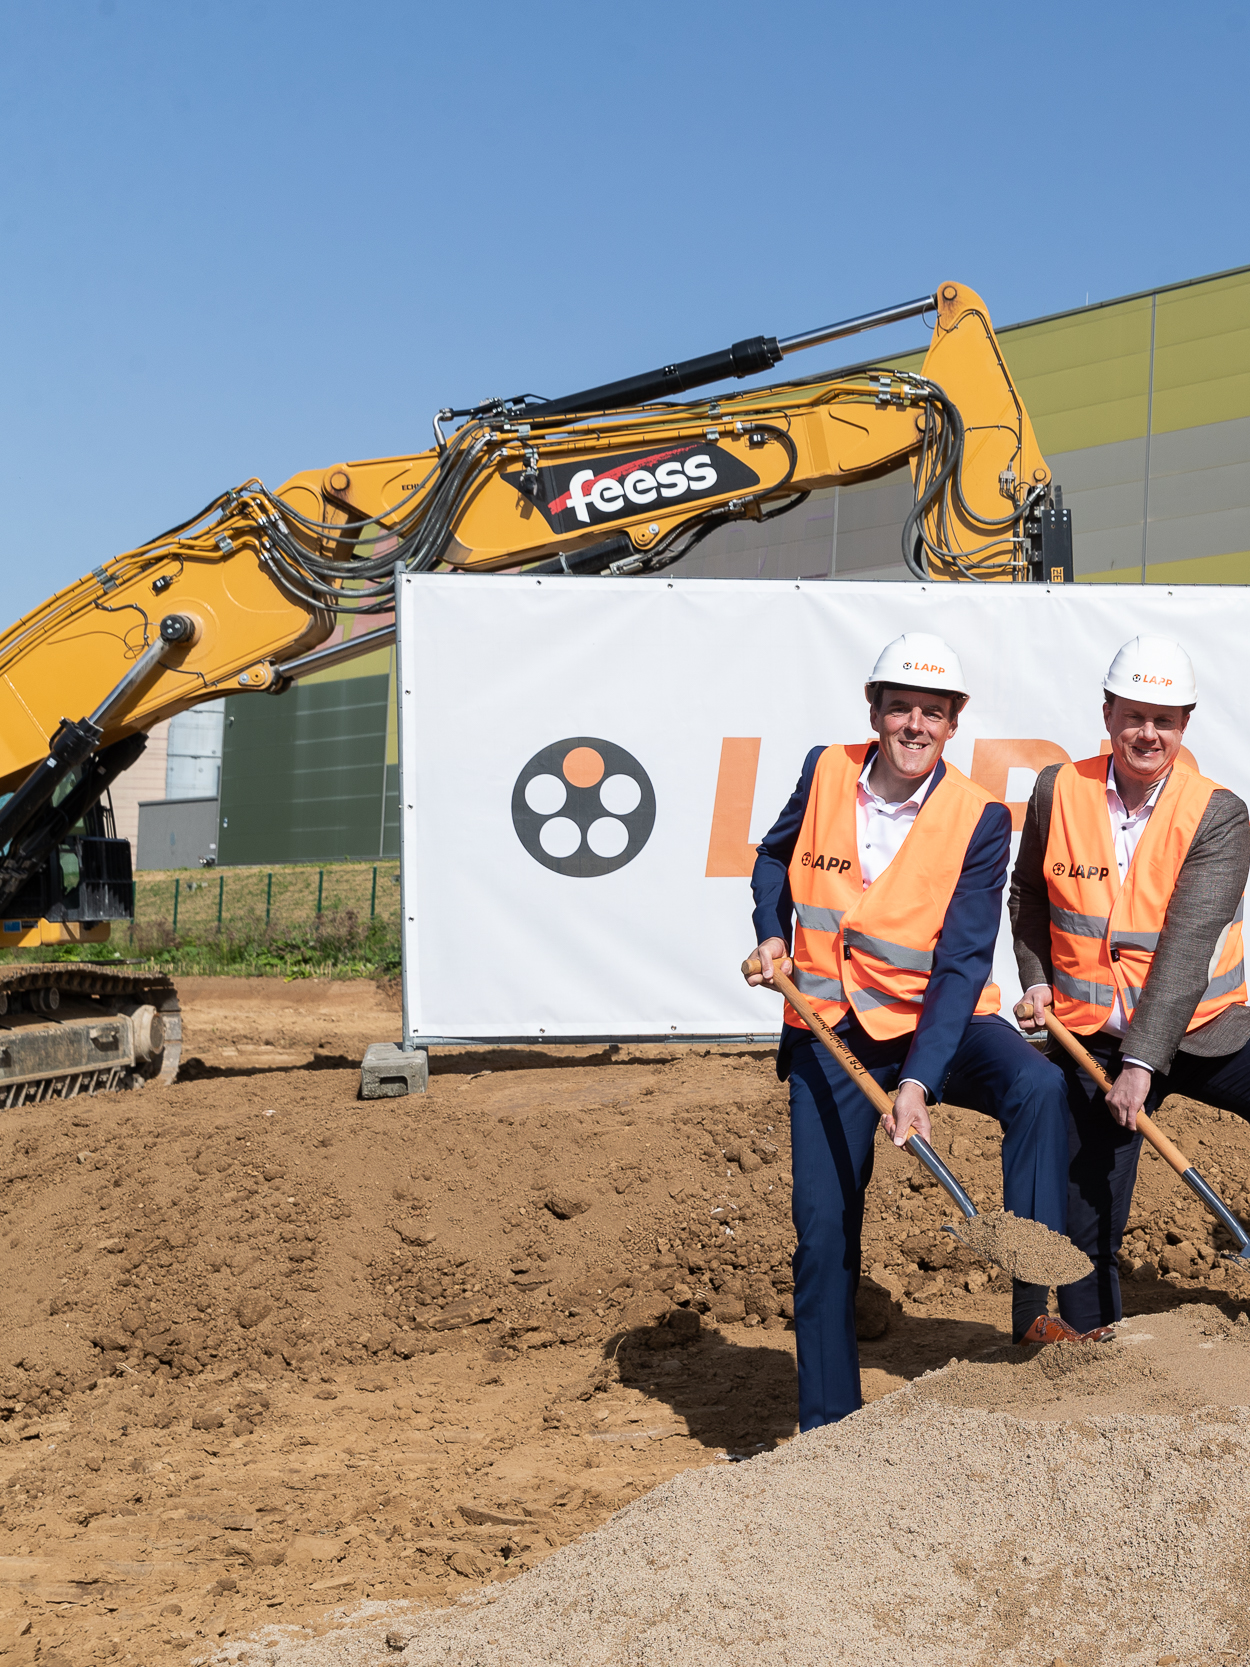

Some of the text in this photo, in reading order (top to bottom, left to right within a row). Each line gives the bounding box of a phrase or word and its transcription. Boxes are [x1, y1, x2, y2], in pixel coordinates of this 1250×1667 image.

[566, 454, 718, 523] feess
[914, 662, 946, 675] LAPP
[1143, 674, 1173, 687] LAPP
[1068, 863, 1109, 881] LAPP
